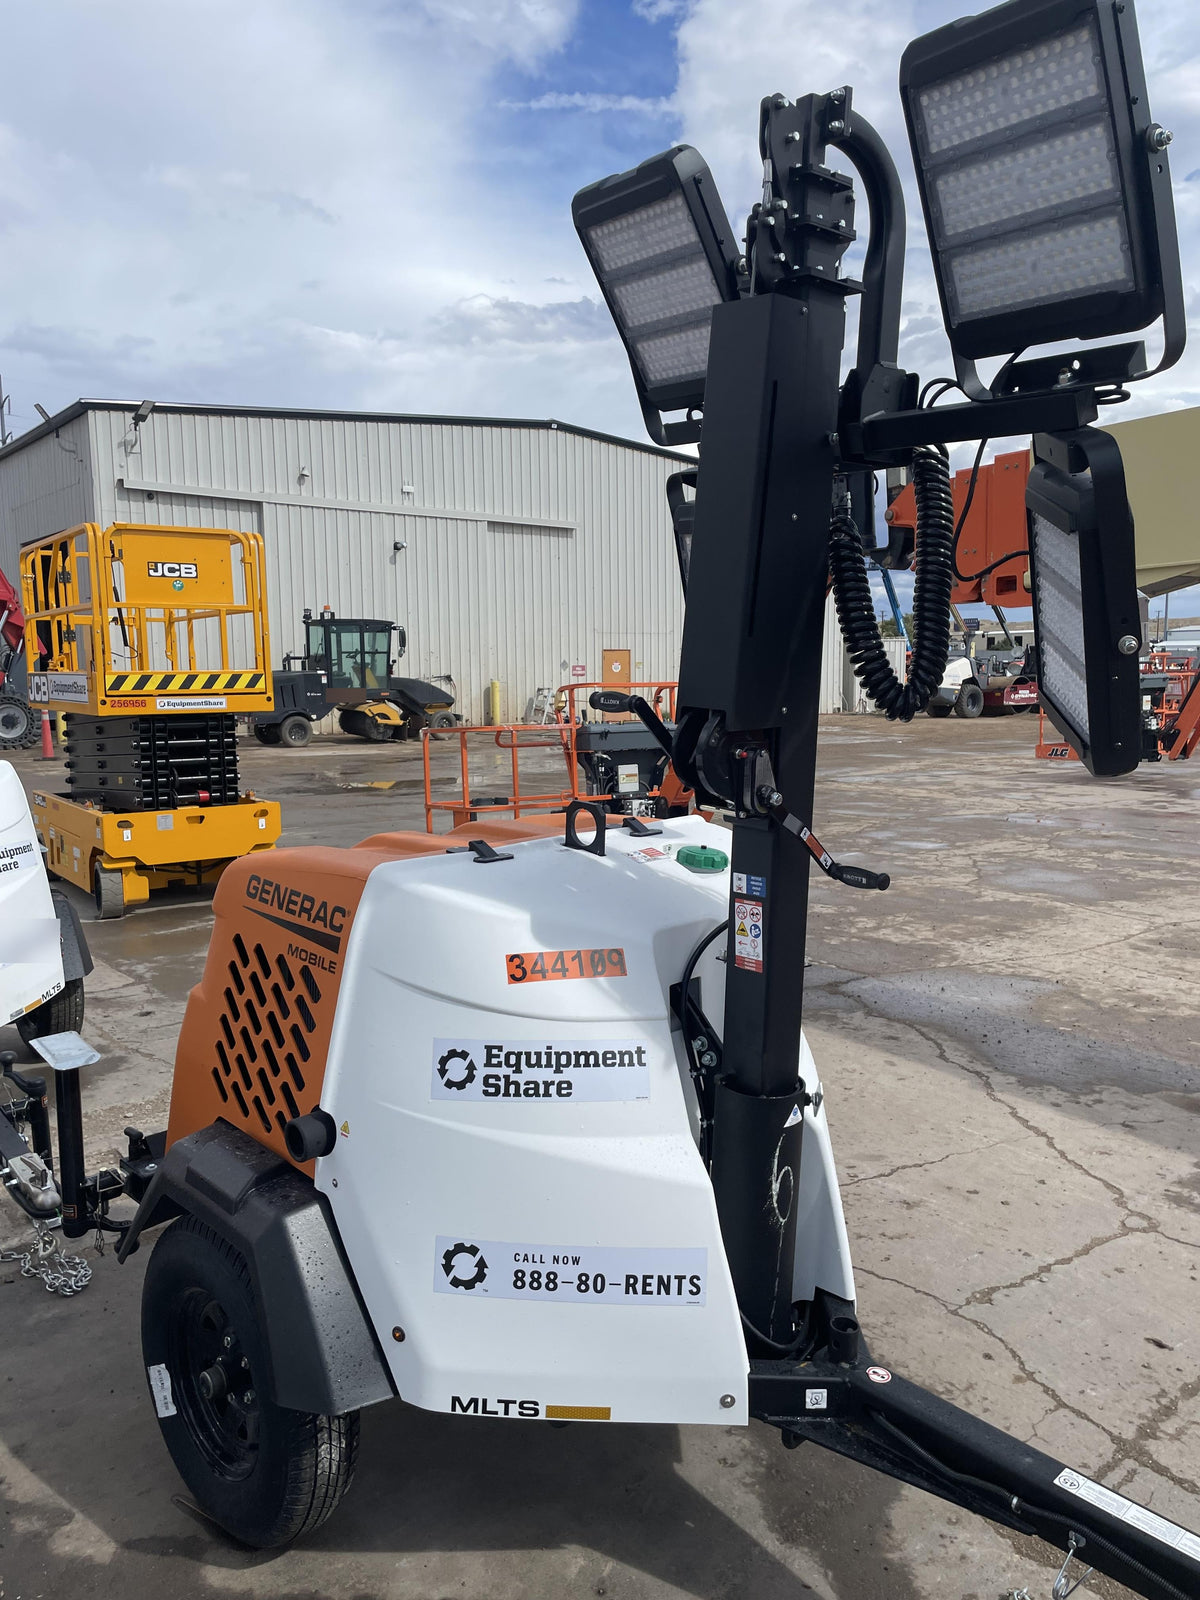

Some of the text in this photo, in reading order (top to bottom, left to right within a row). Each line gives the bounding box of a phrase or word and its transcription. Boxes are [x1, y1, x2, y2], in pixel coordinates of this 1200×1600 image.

[148, 562, 197, 578] JCB
[29, 675, 49, 701] JCB
[110, 699, 147, 708] 256956
[166, 700, 224, 708] EquipmentShare
[1048, 747, 1069, 757] JLG
[246, 874, 346, 933] GENERAC
[287, 943, 337, 975] MOBILE
[508, 949, 626, 982] 344109
[41, 982, 62, 1002] MLTS
[483, 1044, 647, 1075] Equipment
[482, 1073, 573, 1098] Share
[513, 1252, 581, 1266] CALL NOW
[512, 1269, 701, 1296] 888-80-RENTS
[451, 1395, 540, 1417] MLTS
